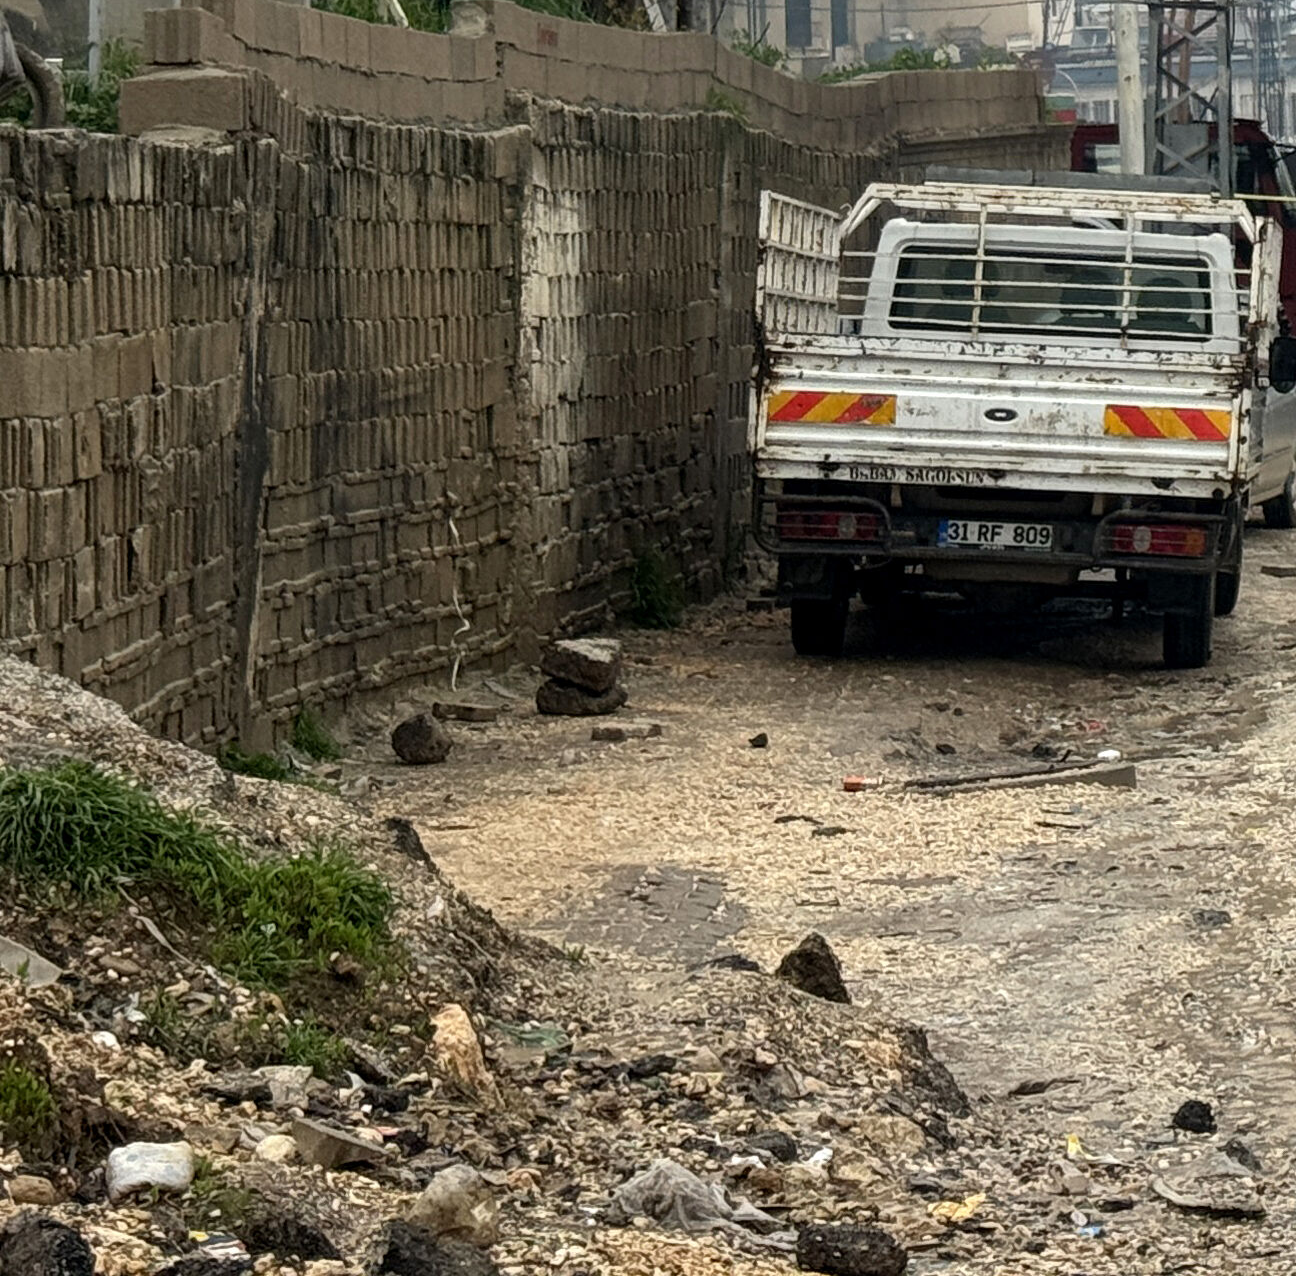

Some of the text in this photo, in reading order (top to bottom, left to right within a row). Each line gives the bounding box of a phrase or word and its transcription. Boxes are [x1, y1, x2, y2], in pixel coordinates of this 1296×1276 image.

[948, 522, 1050, 545] 31 RF 809
